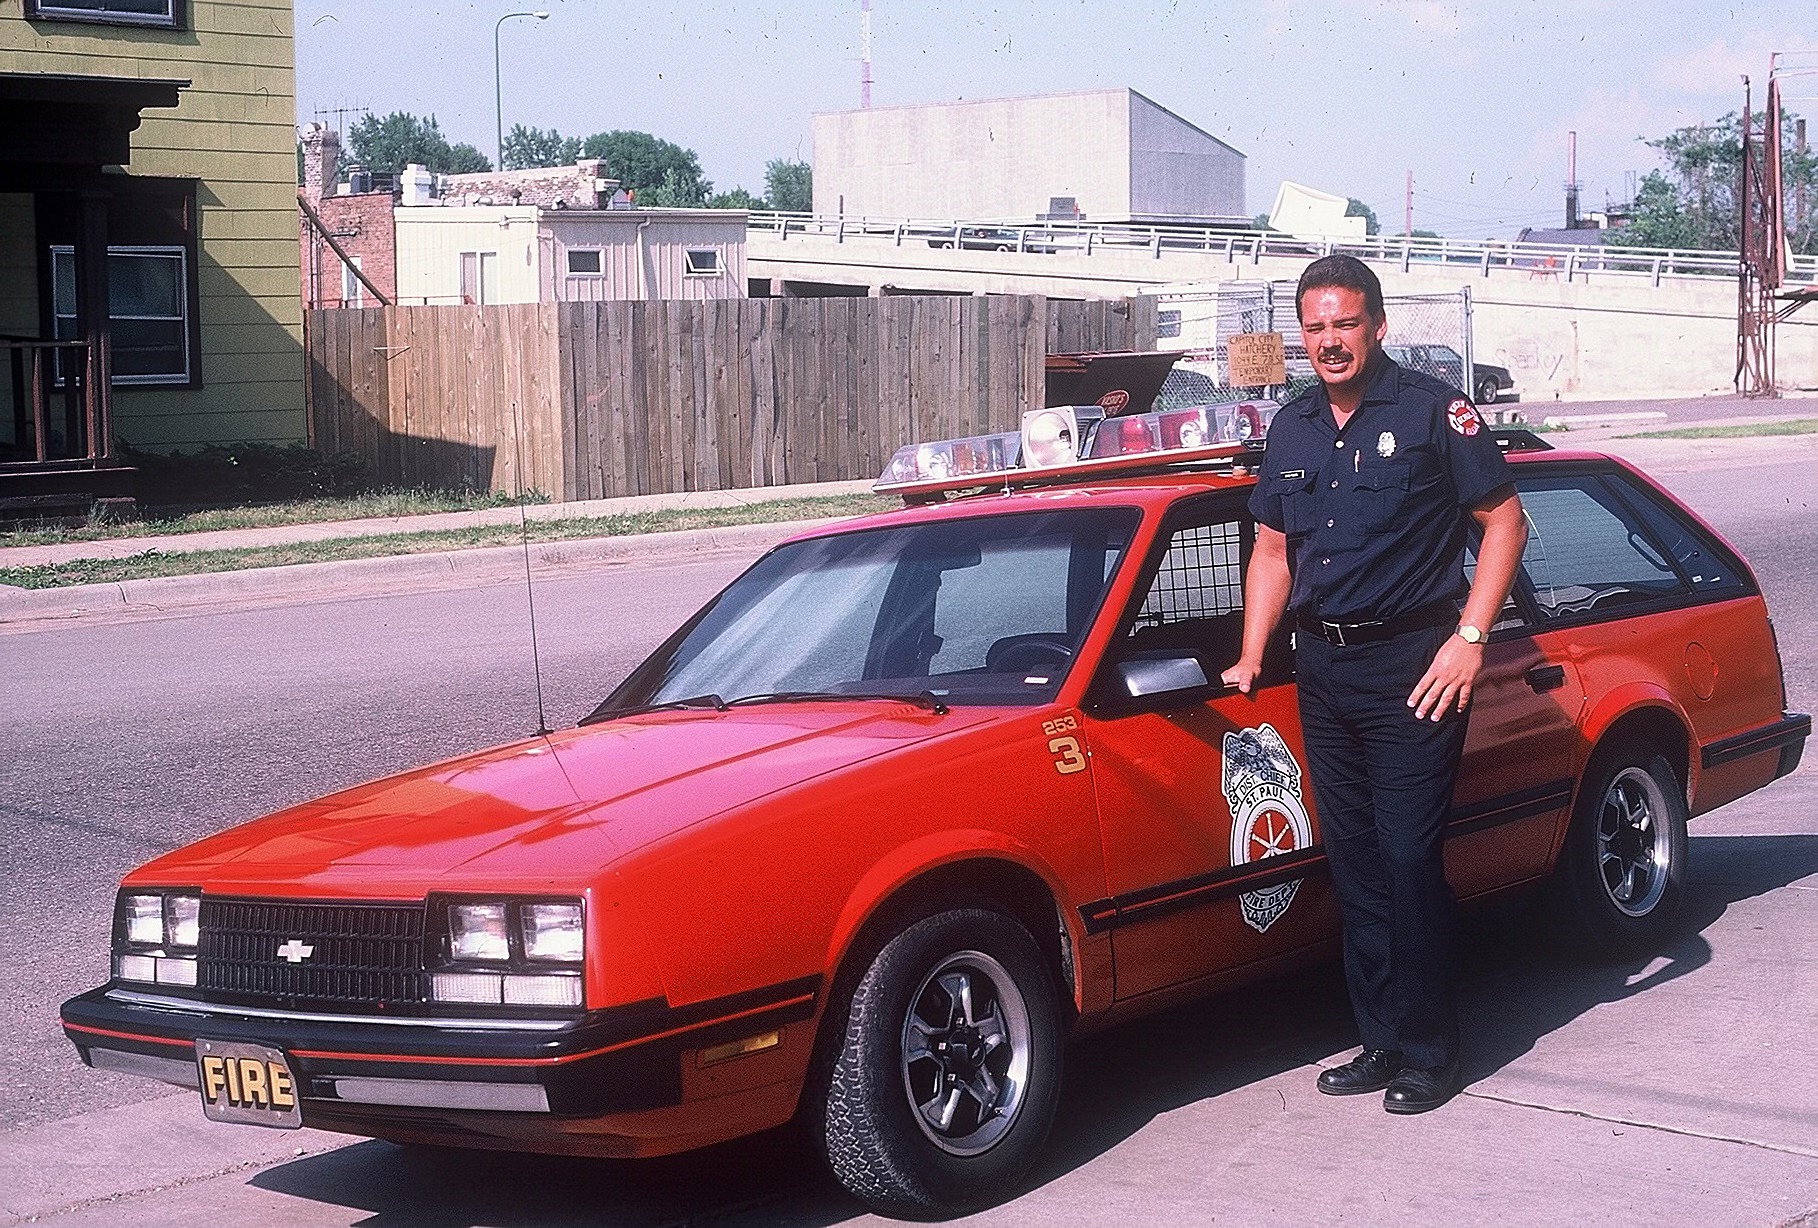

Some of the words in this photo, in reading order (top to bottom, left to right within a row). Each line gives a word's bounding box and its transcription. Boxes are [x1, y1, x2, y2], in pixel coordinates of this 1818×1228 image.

[1240, 343, 1277, 354] HATCHERY
[1259, 335, 1274, 344] CITY
[1041, 716, 1077, 735] 253
[1048, 736, 1086, 774] 3
[1240, 775, 1258, 796] DIST.
[1260, 770, 1286, 784] CHIEF
[1246, 792, 1259, 808] ST.
[1260, 786, 1285, 801] PAUL
[1245, 892, 1265, 909] FIRE
[201, 1055, 294, 1111] FIRE
